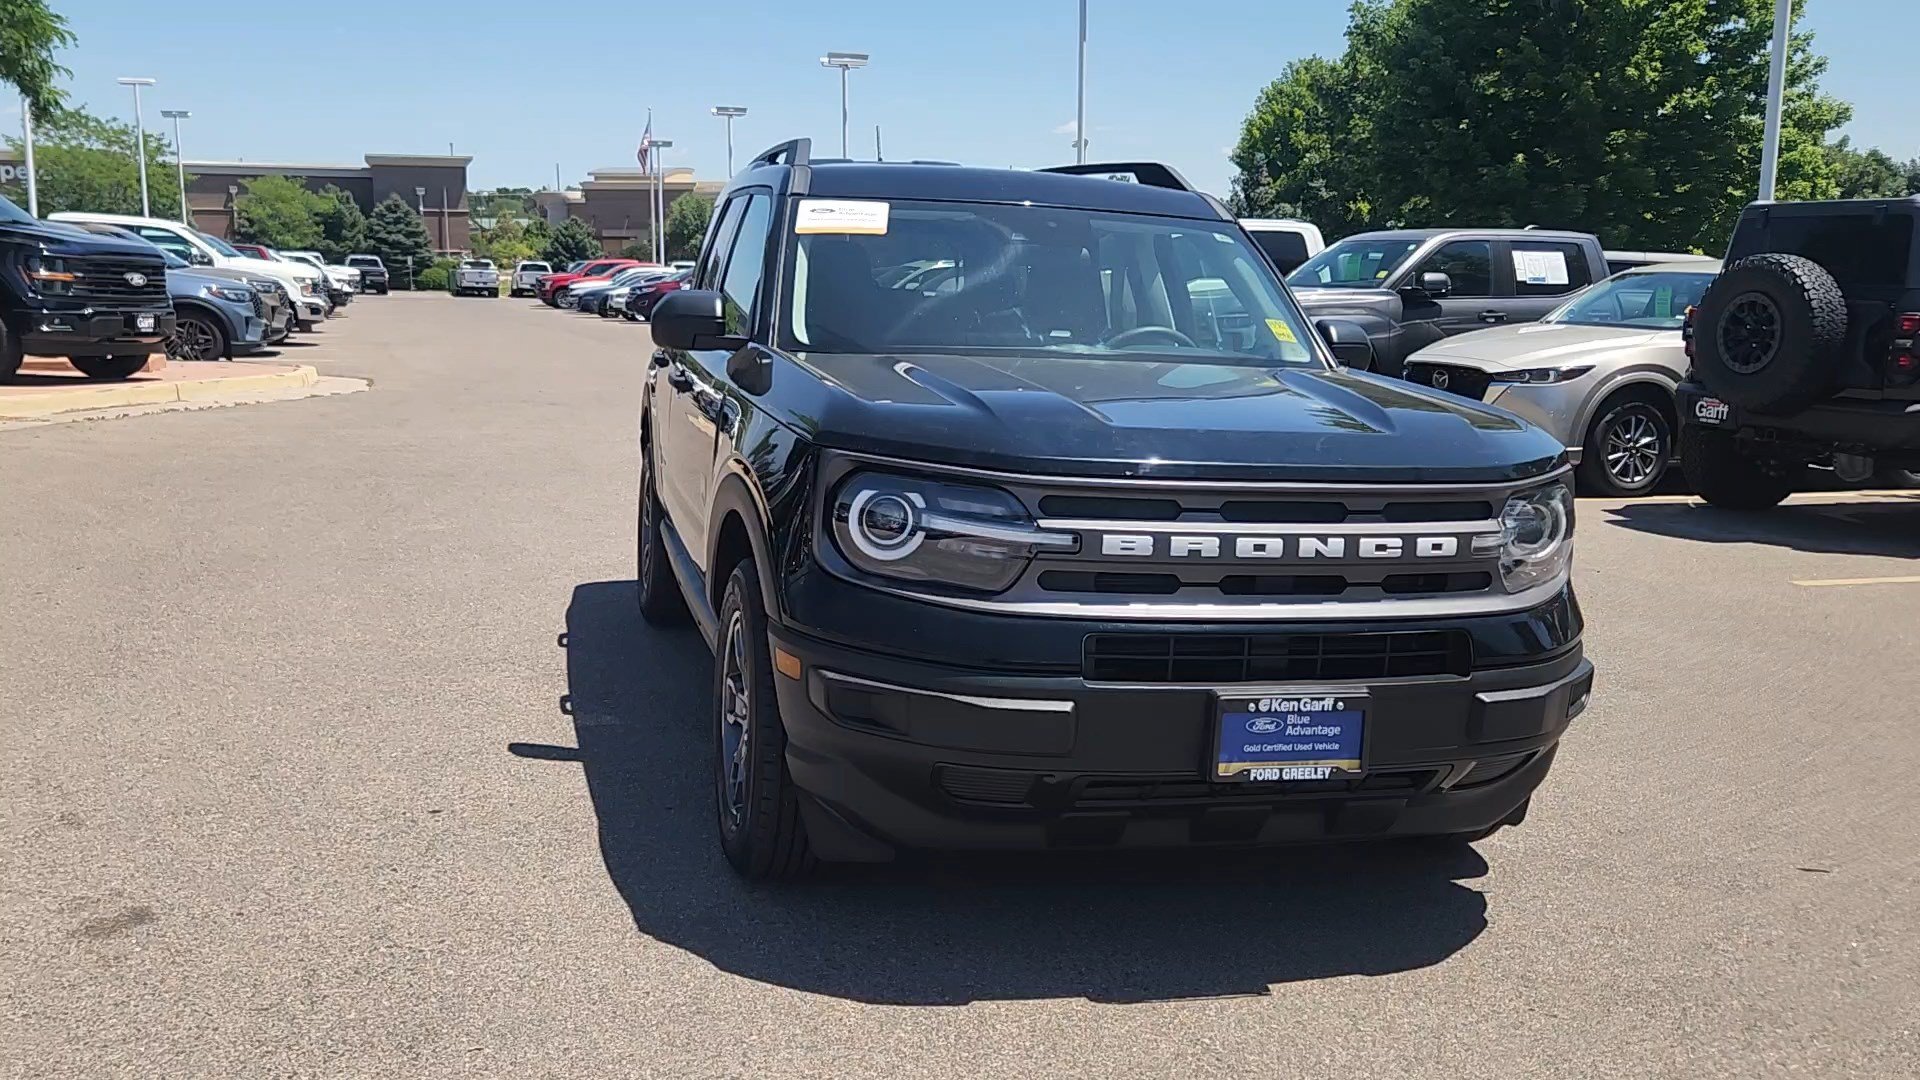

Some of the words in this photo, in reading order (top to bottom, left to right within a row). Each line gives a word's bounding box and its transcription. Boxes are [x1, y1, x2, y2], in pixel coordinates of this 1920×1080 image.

[1695, 401, 1729, 420] Garff
[1101, 534, 1458, 558] BRONCO
[1271, 698, 1298, 712] Ken
[1299, 697, 1335, 712] Garff
[1286, 714, 1311, 725] Blue
[1285, 725, 1341, 737] Advantage
[1243, 744, 1261, 752] Gold
[1262, 743, 1293, 752] Certified
[1293, 742, 1313, 751] Used
[1314, 741, 1340, 751] Vehicle
[1250, 769, 1280, 781] FORD
[1282, 767, 1332, 780] GREELEY
